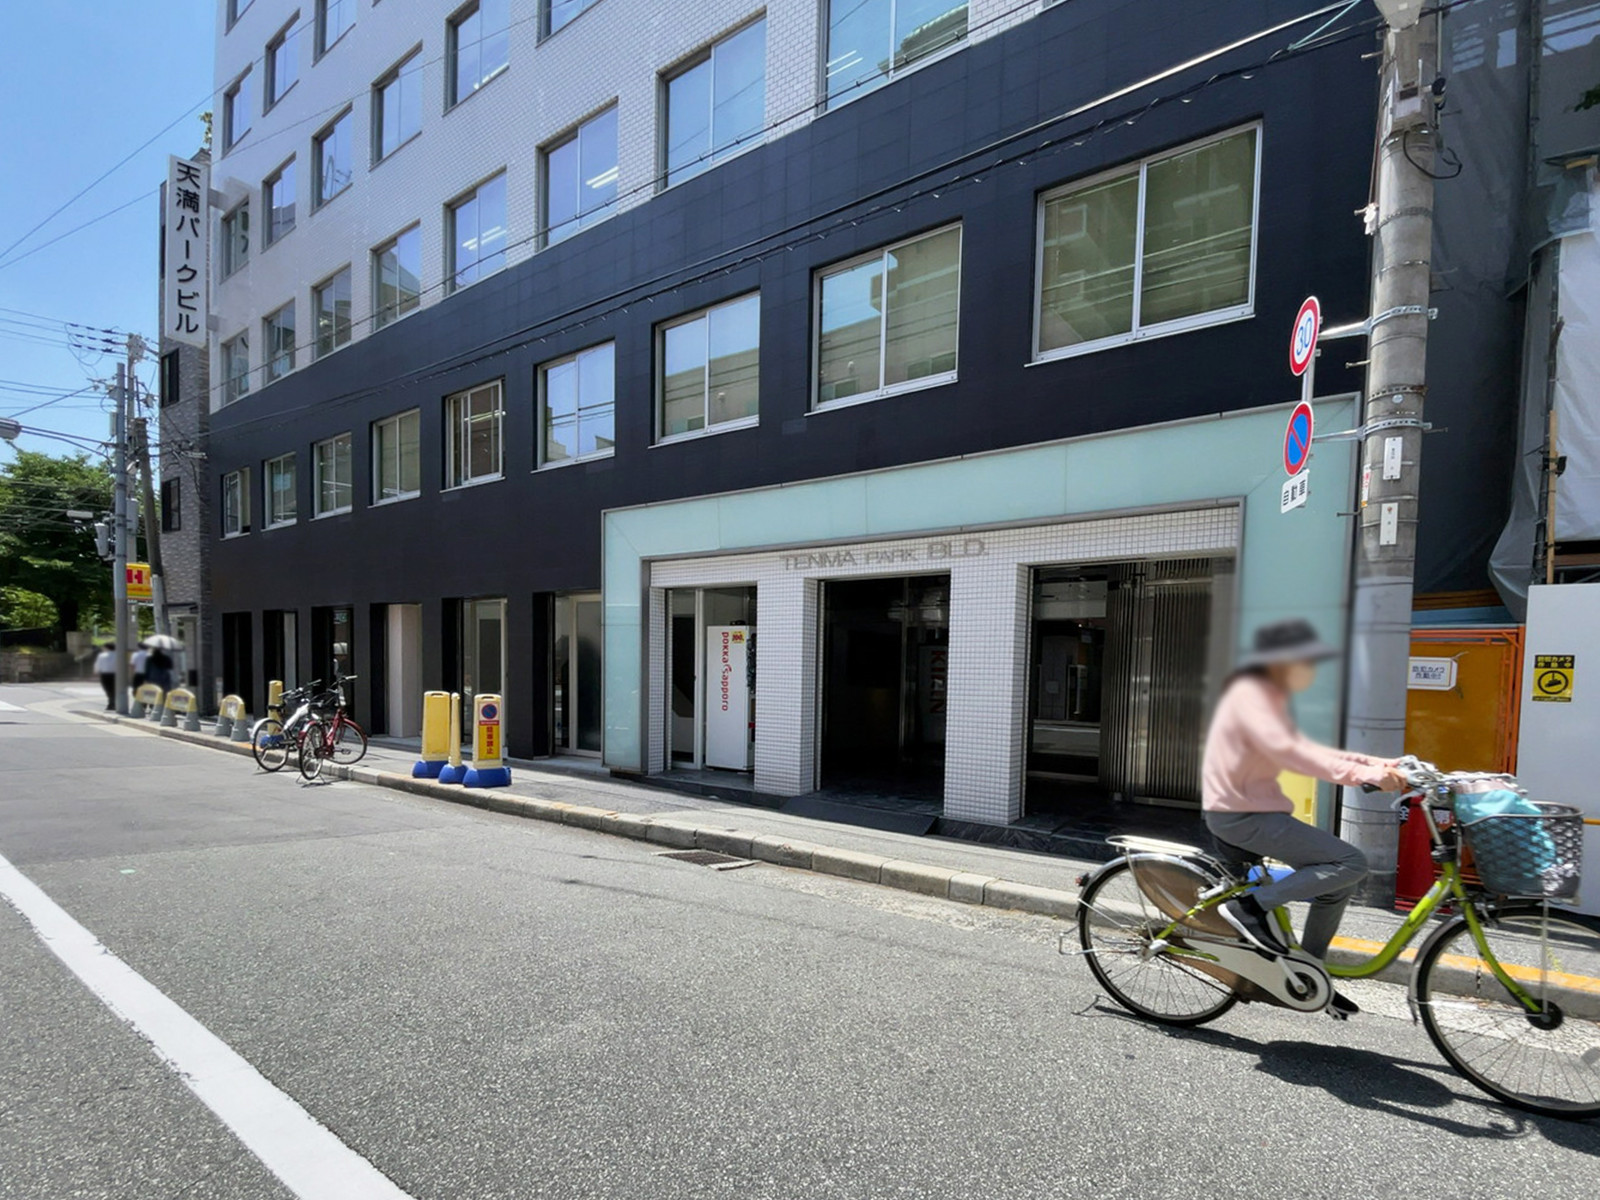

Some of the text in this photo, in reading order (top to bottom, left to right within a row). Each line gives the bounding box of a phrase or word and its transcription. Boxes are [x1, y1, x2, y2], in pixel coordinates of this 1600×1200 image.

[176, 161, 200, 334] 天満パークビル
[1296, 317, 1312, 356] 30
[780, 550, 858, 571] TENMA
[865, 548, 918, 565] PARK
